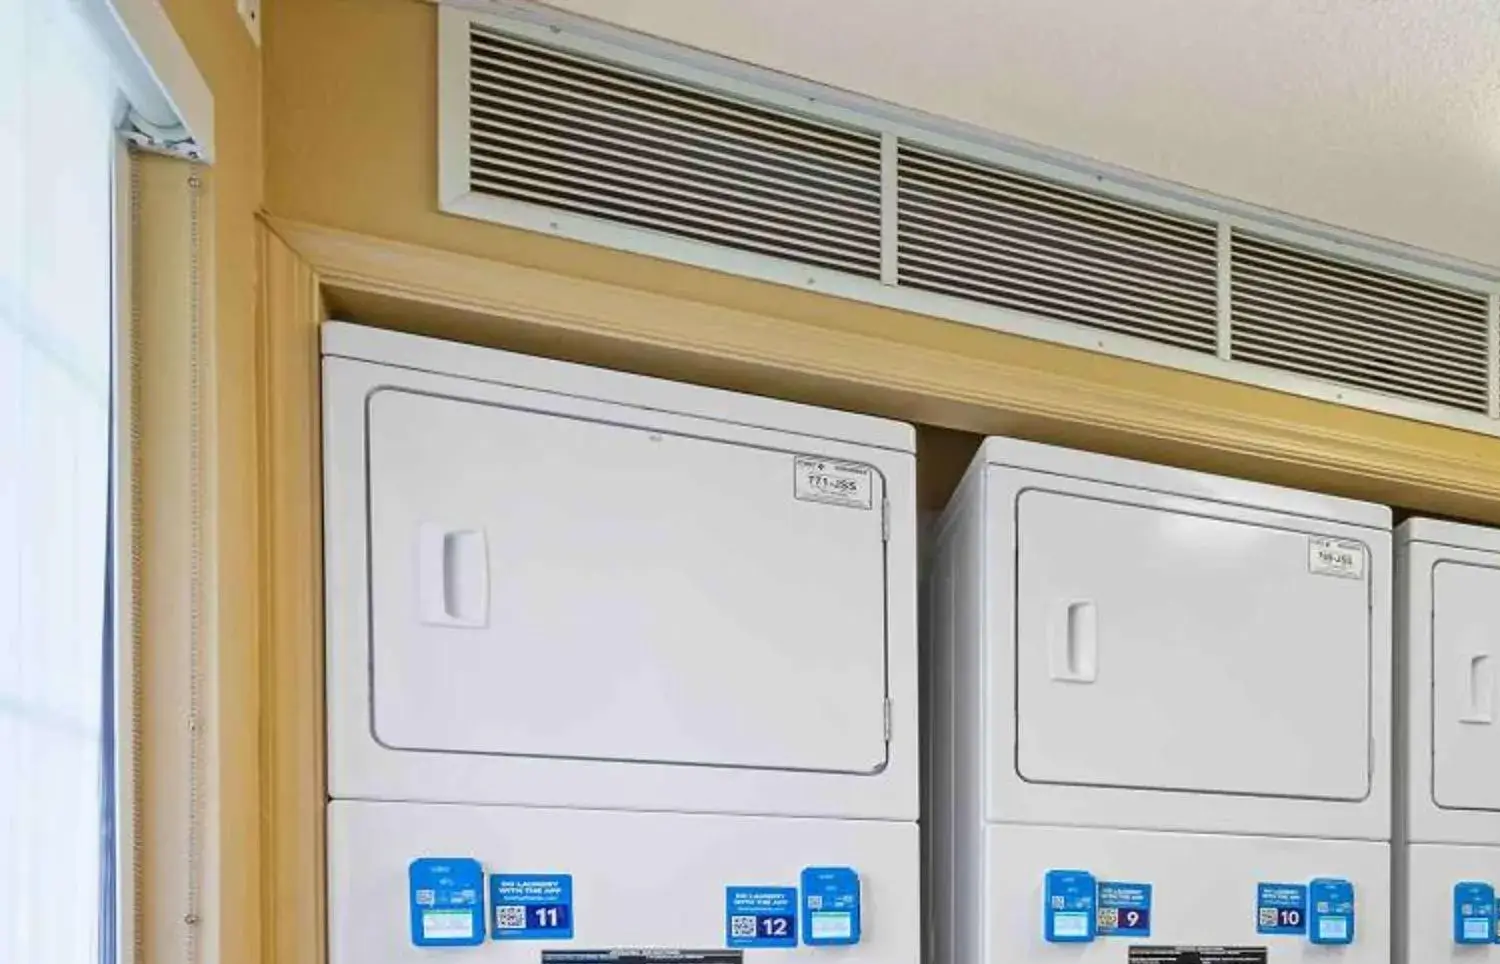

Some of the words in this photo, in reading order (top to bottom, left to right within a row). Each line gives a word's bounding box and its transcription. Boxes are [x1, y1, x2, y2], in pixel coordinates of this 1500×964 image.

[535, 907, 558, 927] 11
[1127, 911, 1139, 927] 9
[1281, 910, 1300, 926] 10
[762, 917, 788, 937] 12
